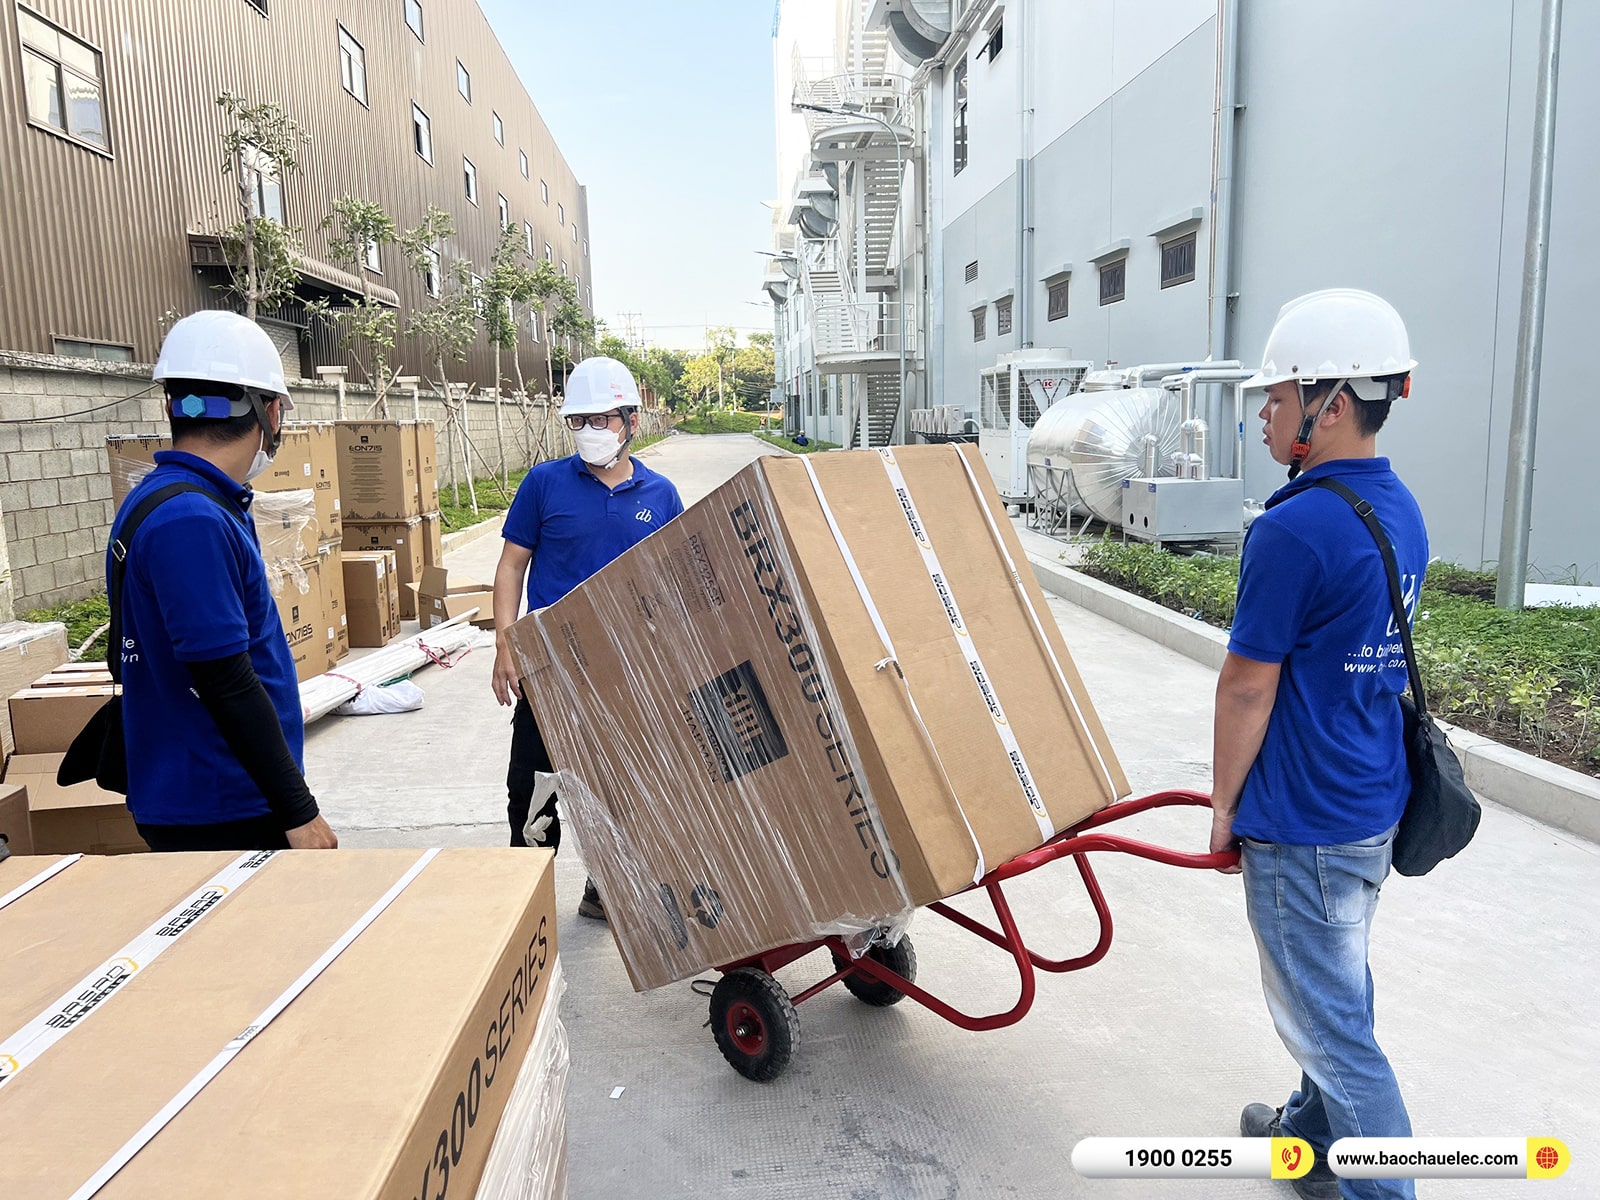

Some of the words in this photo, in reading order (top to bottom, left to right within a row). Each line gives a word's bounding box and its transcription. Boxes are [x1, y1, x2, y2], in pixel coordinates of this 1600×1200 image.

[635, 508, 652, 523] db
[286, 623, 313, 644] ON718S
[723, 686, 764, 754] JBL
[729, 501, 827, 705] BRX300
[815, 710, 898, 880] SERIES
[485, 915, 547, 1088] SERIES
